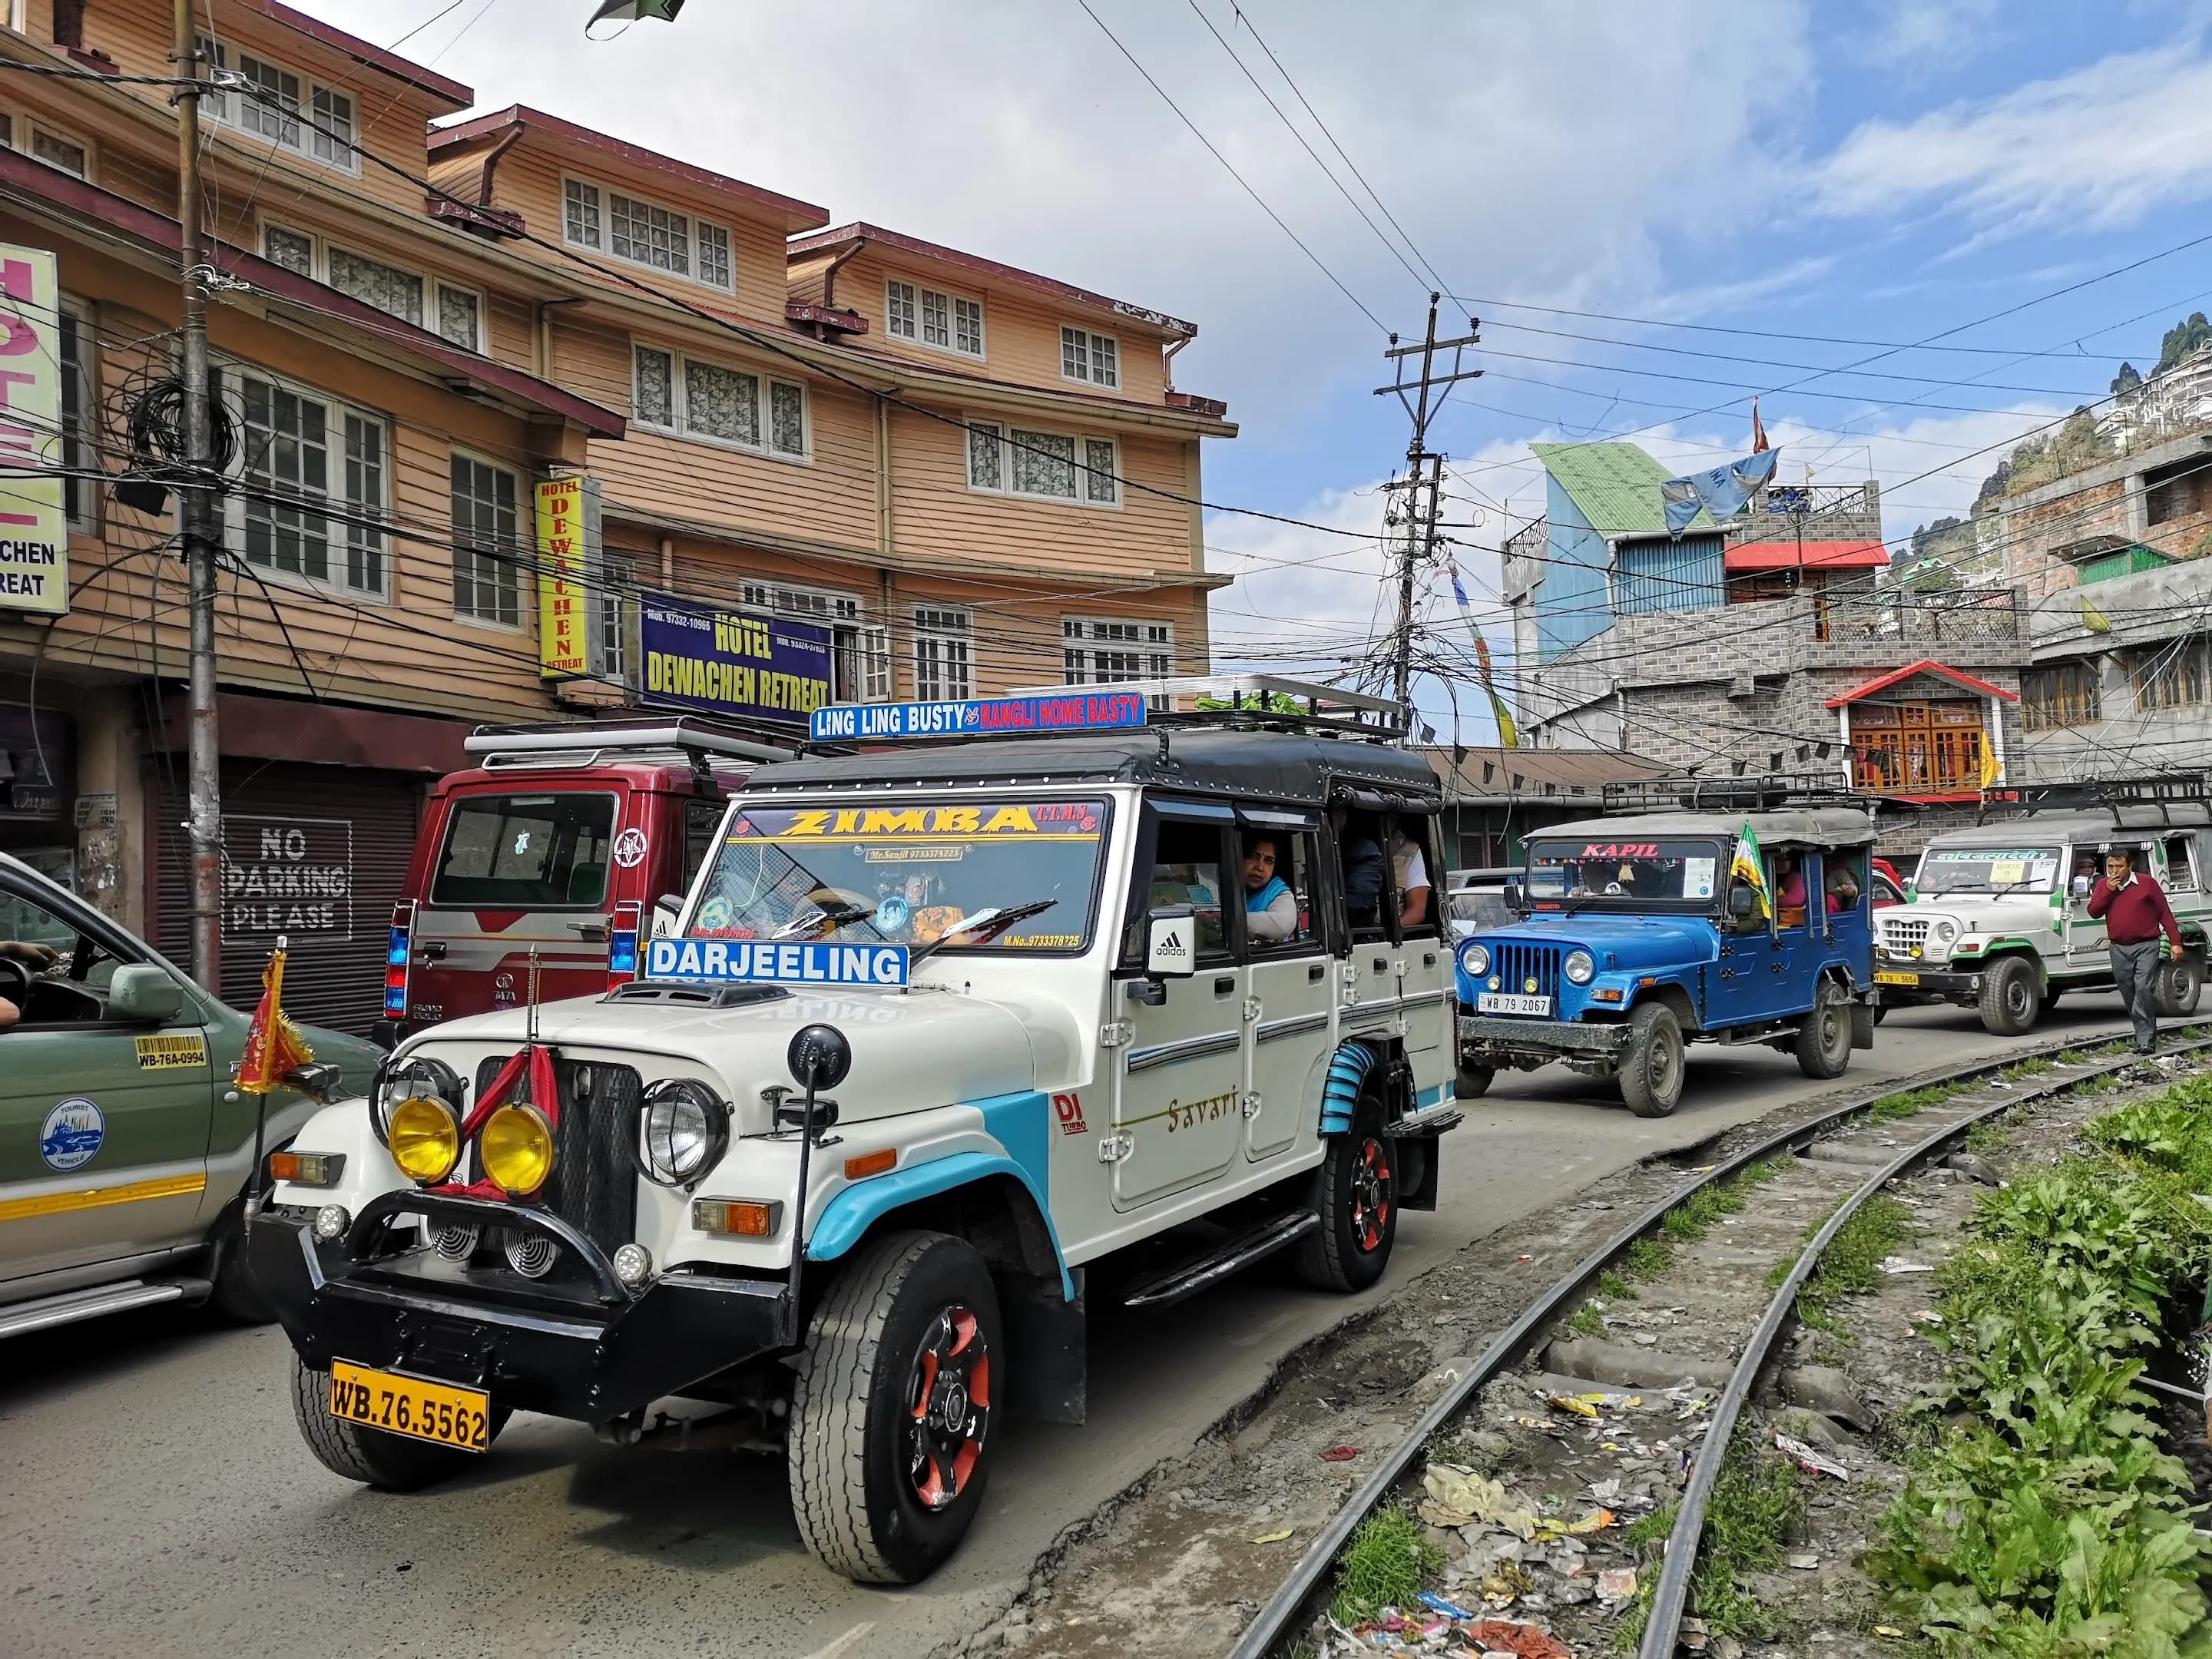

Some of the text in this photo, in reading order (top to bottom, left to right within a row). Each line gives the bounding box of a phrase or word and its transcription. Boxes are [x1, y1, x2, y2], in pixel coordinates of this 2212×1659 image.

[541, 482, 578, 496] HOTEL
[666, 613, 710, 631] 97332-10966
[715, 614, 772, 660] HOTEL
[546, 657, 584, 671] RETREAT
[648, 651, 828, 713] DEWACHEN RETREAT
[817, 704, 966, 736] LING LING BUSTY
[980, 694, 1141, 730] RANGLI HOME BASTY
[779, 805, 1039, 836] ZIMBA
[260, 828, 306, 860] NO
[1581, 843, 1660, 857] KAPIL
[227, 866, 346, 897] PARKING
[233, 902, 335, 930] PLEASE
[654, 942, 901, 984] DARJEELING
[1156, 945, 1186, 956] adidas
[492, 991, 516, 1001] TATA
[1487, 997, 1547, 1012] WB 79 2067
[140, 1051, 204, 1067] WB-76A-0994
[61, 1104, 89, 1114] TOURIST
[1052, 1093, 1084, 1123] DI
[1167, 1084, 1240, 1134] Savari
[1061, 1121, 1088, 1133] TURBO
[57, 1154, 84, 1164] VEHICLE
[333, 1378, 487, 1447] WB.76.5562
